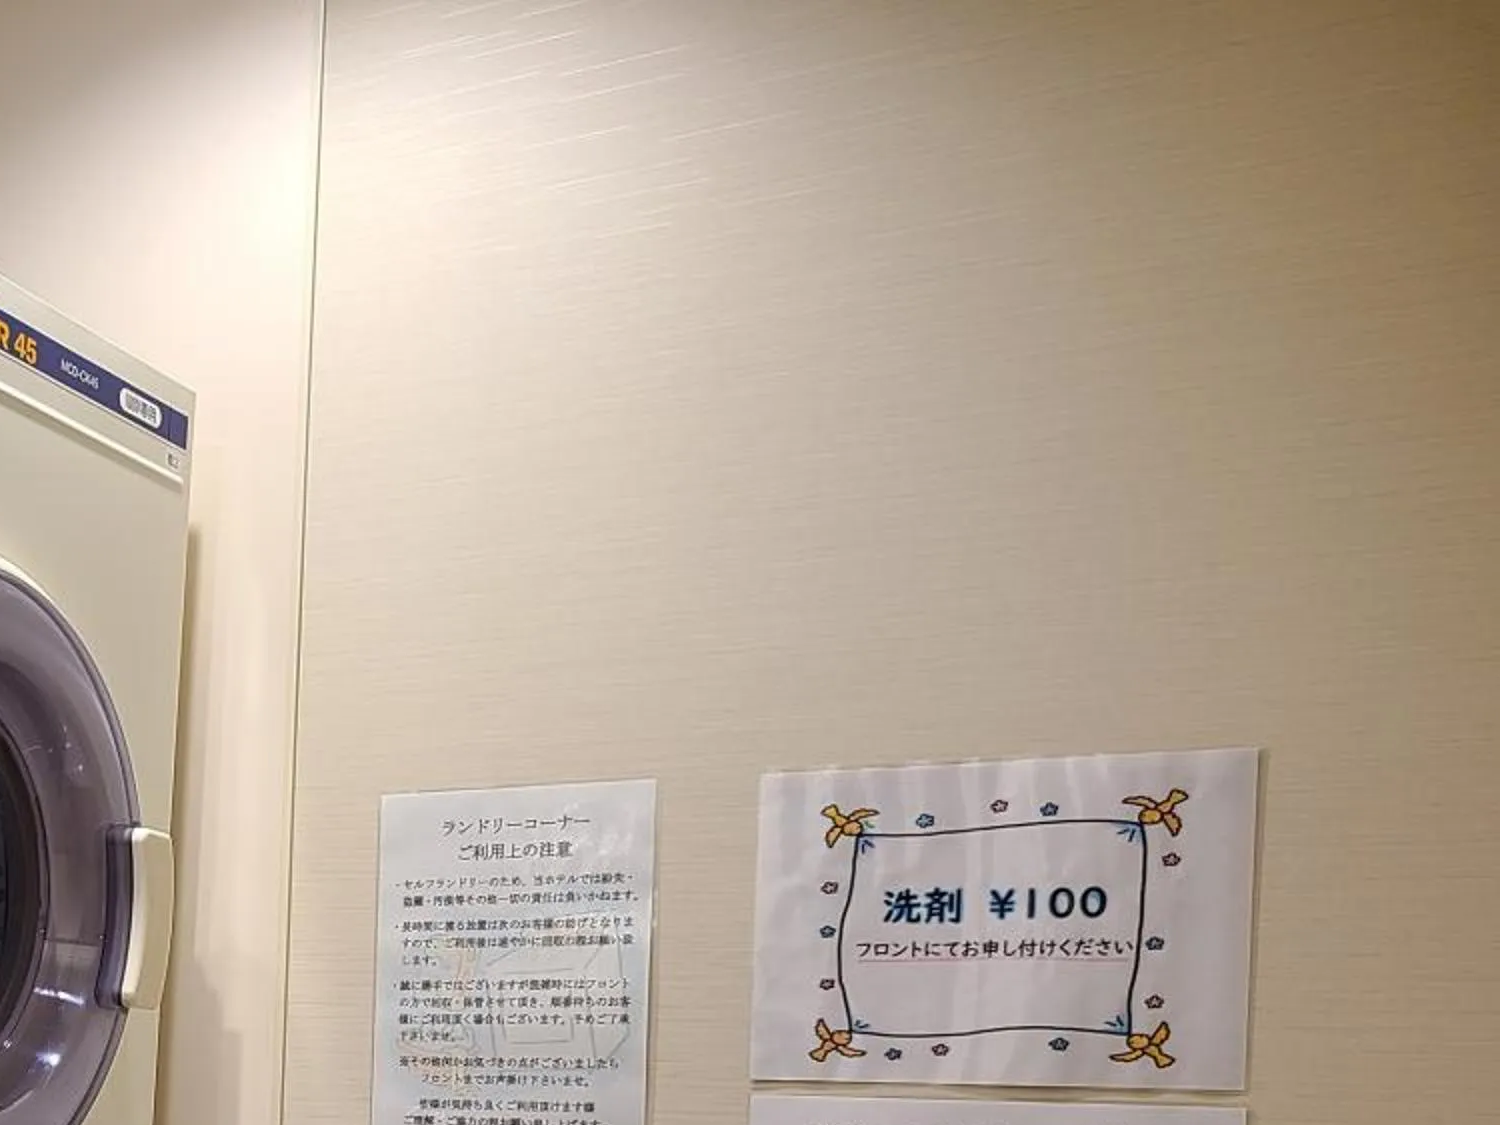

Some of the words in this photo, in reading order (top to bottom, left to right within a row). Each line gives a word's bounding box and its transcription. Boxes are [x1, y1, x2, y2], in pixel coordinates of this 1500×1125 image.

[14, 332, 37, 367] 45
[442, 815, 590, 836] ランドリーコーナー
[458, 842, 573, 861] ご利用上の注意
[883, 887, 963, 924] 洗剤
[988, 885, 1109, 920] ¥100
[855, 938, 1134, 958] フロントにてお申し付けください
